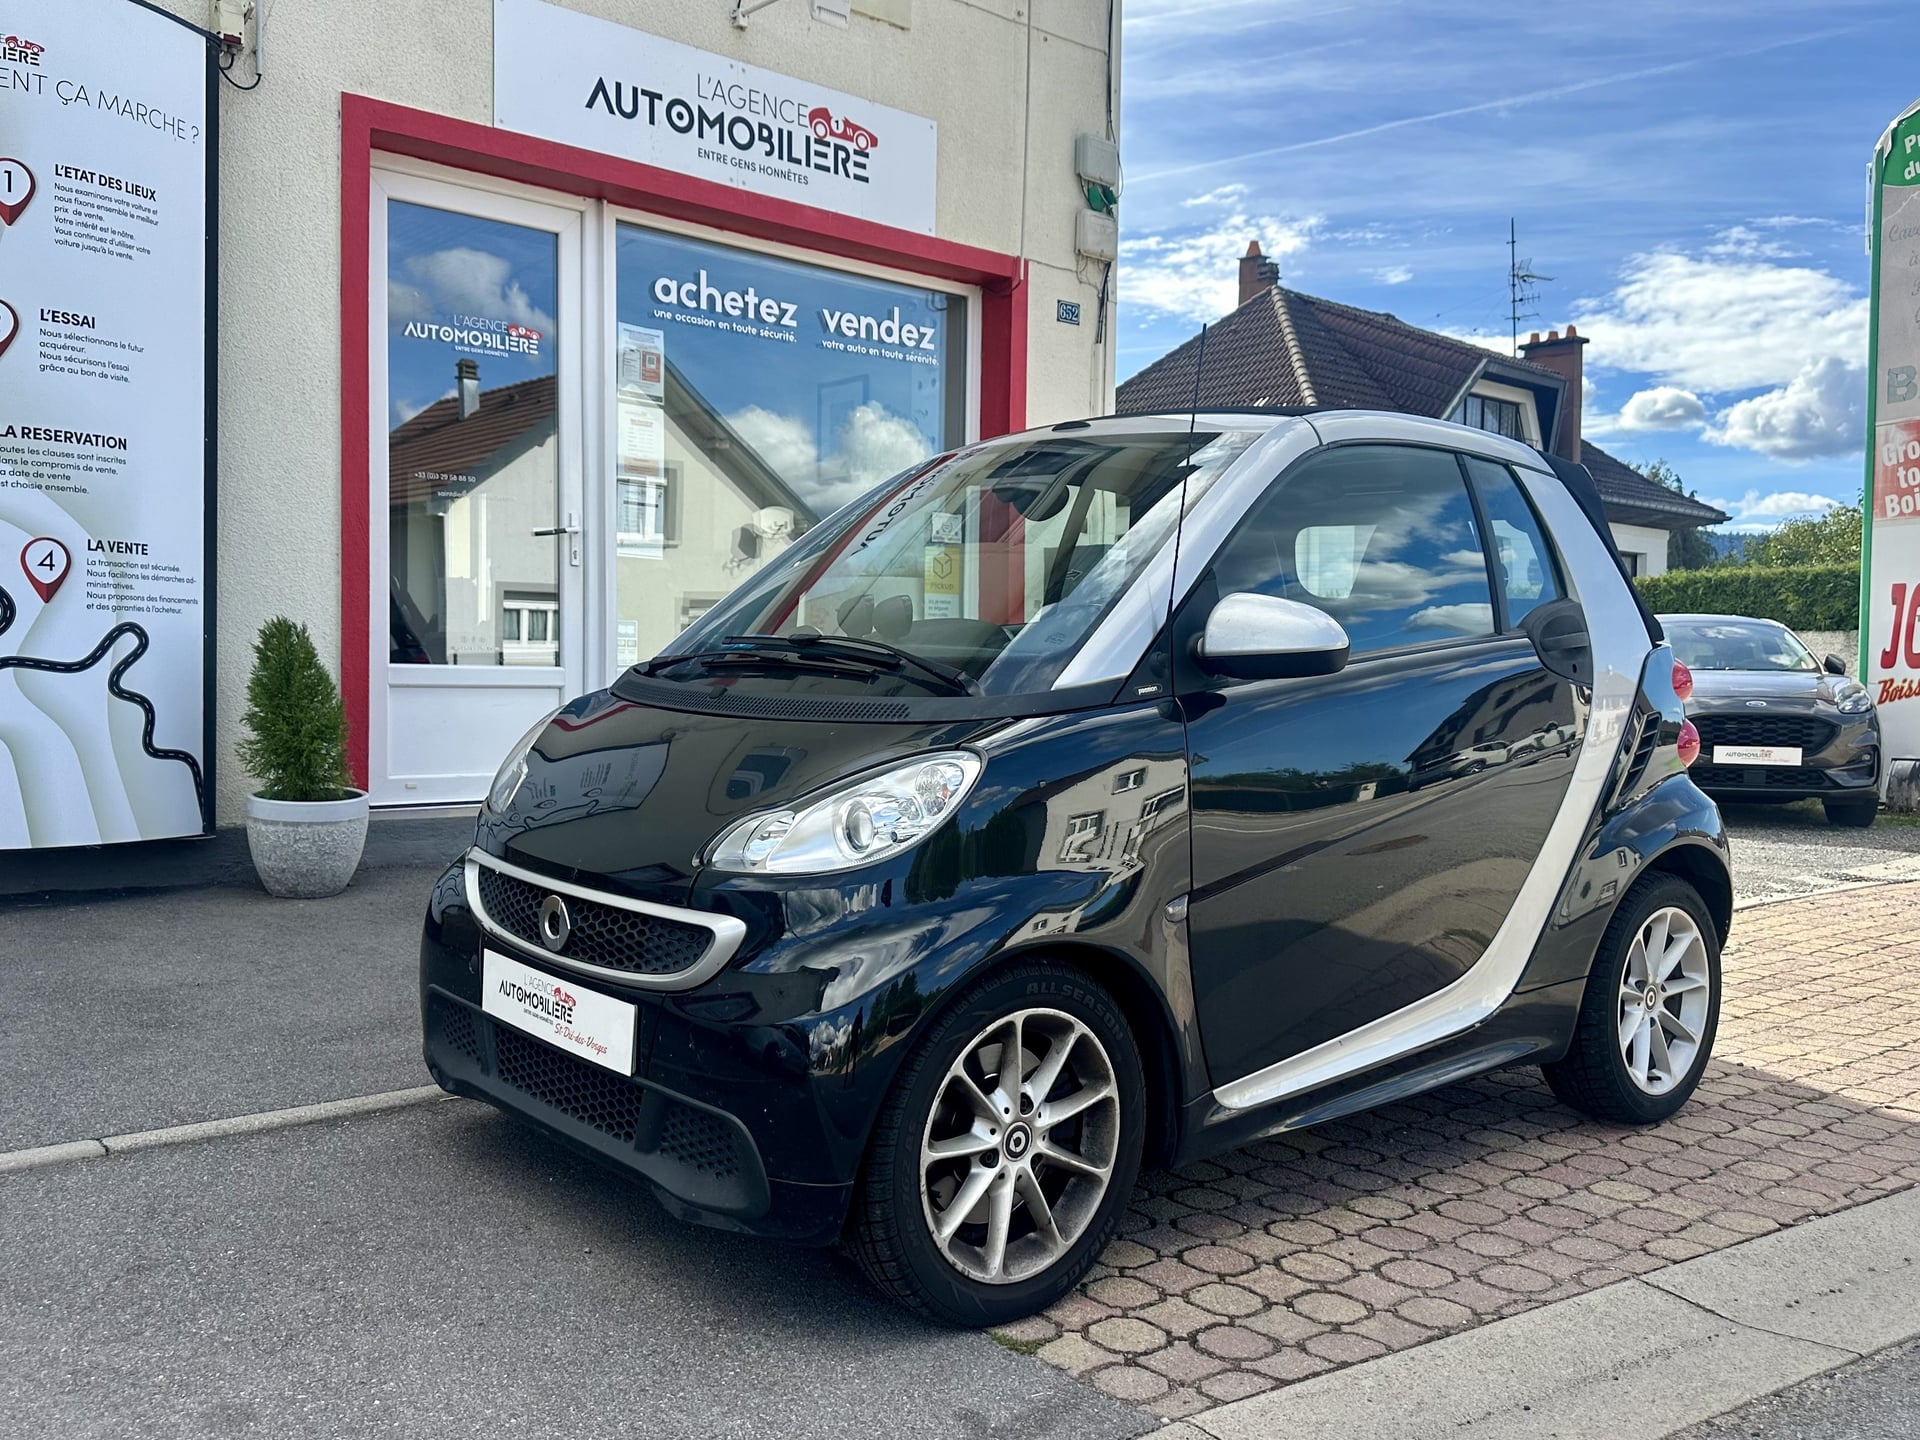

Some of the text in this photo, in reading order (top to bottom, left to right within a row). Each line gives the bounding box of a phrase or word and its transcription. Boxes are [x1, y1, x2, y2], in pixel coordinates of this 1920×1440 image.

[0, 46, 40, 67] IERE
[56, 80, 90, 107] ÇA
[98, 90, 186, 140] MARCHE
[190, 125, 200, 144] ?
[696, 73, 809, 129] L'AGENCE
[697, 148, 809, 186] ENTRE GENS HONNÊTES
[4, 170, 12, 193] 1
[55, 163, 157, 202] L'ETAT DES LIEUX
[54, 182, 74, 193] Nous
[75, 188, 113, 203] examinons
[114, 198, 131, 207] votre
[131, 202, 151, 213] voiture
[54, 195, 73, 204] nous
[74, 197, 95, 209] fixons
[96, 204, 128, 217] ensemble
[129, 211, 136, 219] le
[54, 204, 105, 222] prix de vente.
[54, 215, 136, 240] Votre intérêt est le nôtre.
[54, 226, 72, 236] Vous
[73, 230, 108, 244] continuez
[136, 246, 151, 255] votre
[54, 238, 135, 261] voiture jusqu'à la vente.
[654, 269, 798, 328] achetez
[40, 308, 96, 329] L'ESSAI
[454, 314, 508, 333] L'AGENCE
[1060, 304, 1078, 321] 652
[654, 309, 797, 343] une occasion en toute sécurité.
[822, 306, 936, 351] vendez
[39, 328, 144, 353] Nous sélectionnons le futur
[39, 341, 86, 354] acquéreur.
[39, 350, 130, 372] Nous sécurisons l'essai
[822, 339, 940, 366] votre auto en toute sérénité.
[39, 363, 65, 373] grâce
[80, 367, 96, 377] bon
[98, 371, 108, 379] de
[110, 374, 131, 383] visite.
[21, 425, 127, 450] RESERVATION
[0, 445, 126, 465] outes les clauses sont inscrites
[0, 456, 118, 475] ans le compromis de vente.
[8, 468, 30, 478] date
[32, 470, 45, 479] de
[46, 472, 71, 481] vente
[10, 479, 43, 490] choisie
[45, 484, 90, 495] ensemble.
[87, 538, 149, 556] LA VENTE
[37, 549, 55, 571] 4
[86, 557, 96, 566] La
[98, 559, 139, 569] transaction
[151, 563, 181, 572] sécurisée.
[86, 569, 106, 578] Nous
[108, 570, 139, 580] facilitons
[151, 573, 185, 583] démarches
[86, 581, 135, 590] ministratives.
[86, 591, 199, 605] Nous proposons des financements
[95, 603, 110, 611] des
[111, 604, 145, 613] garanties
[1026, 982, 1124, 1041] ALL SEASON
